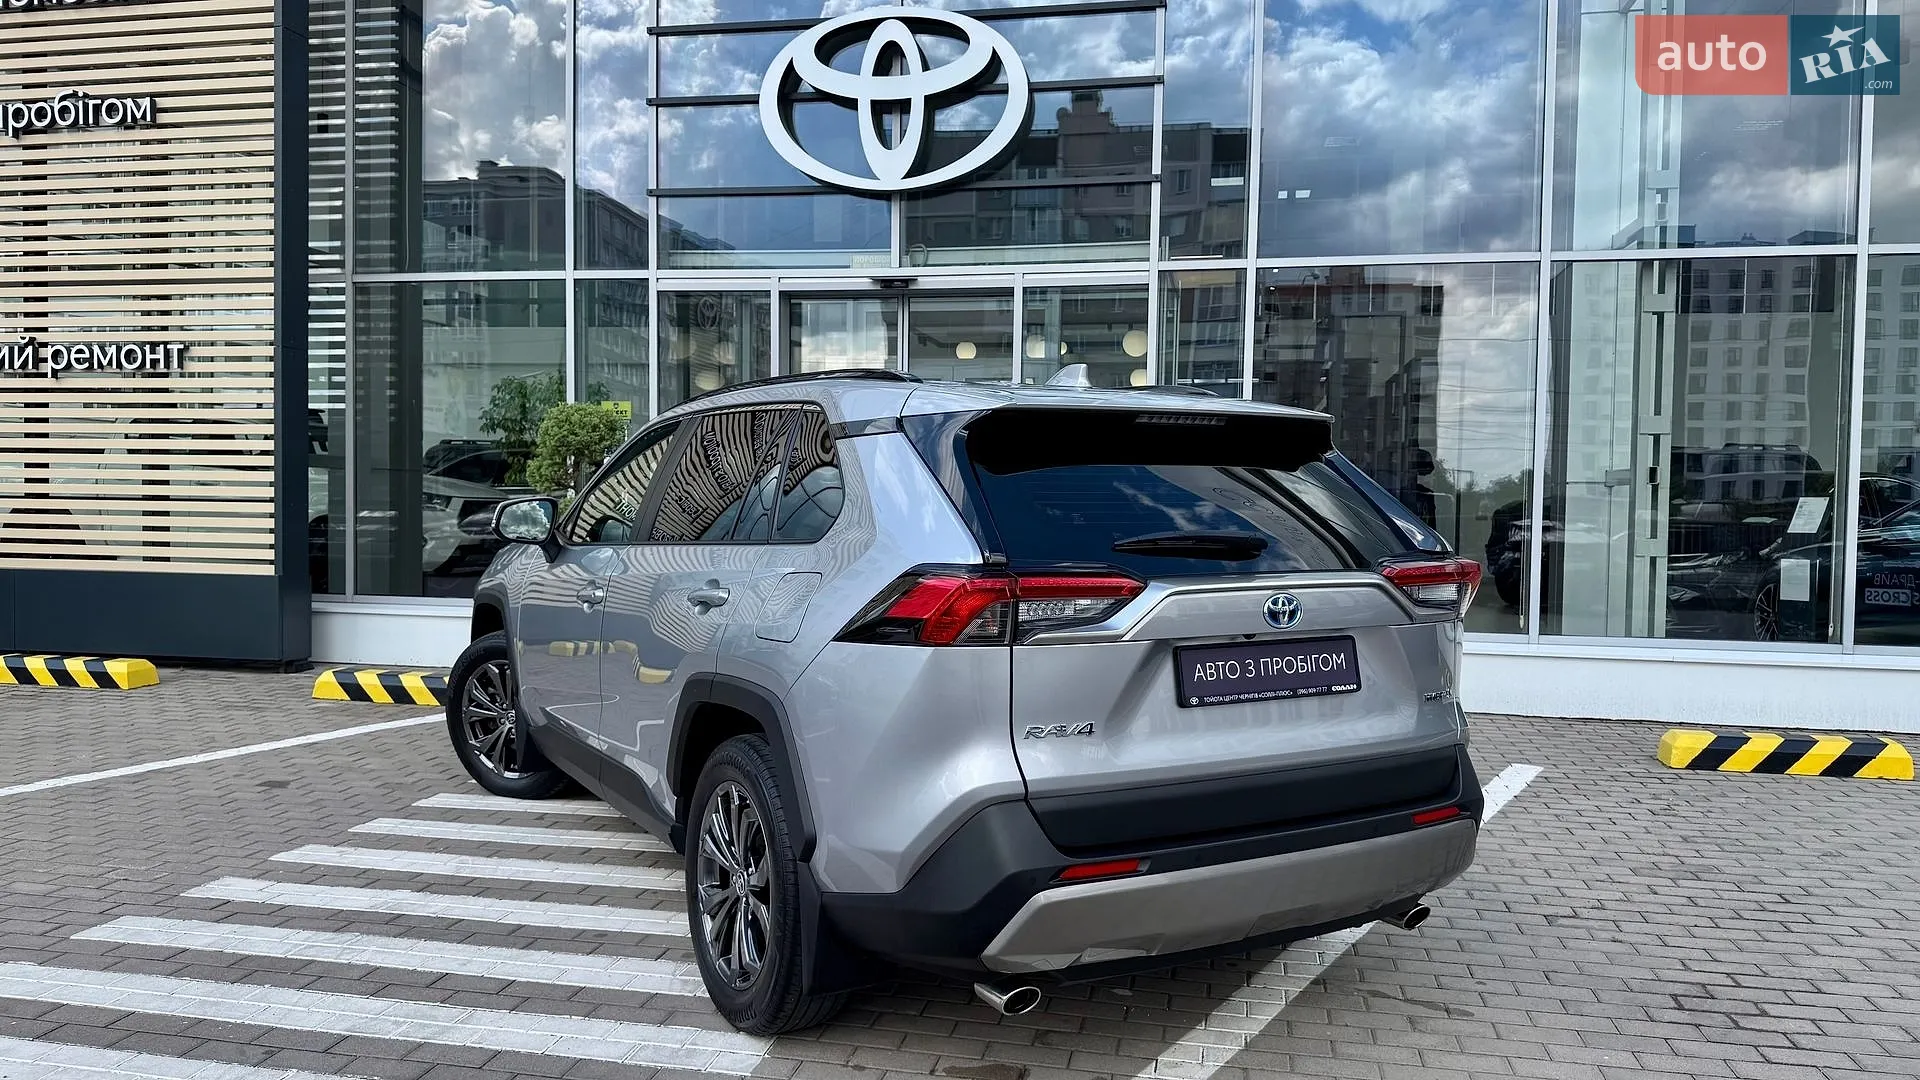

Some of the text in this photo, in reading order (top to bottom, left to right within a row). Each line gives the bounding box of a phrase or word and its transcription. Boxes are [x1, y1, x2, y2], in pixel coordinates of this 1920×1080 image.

[48, 343, 185, 378] ремонт
[1194, 652, 1346, 682] АВТО З ПРОБІГОМ
[1024, 721, 1096, 739] RAV4
